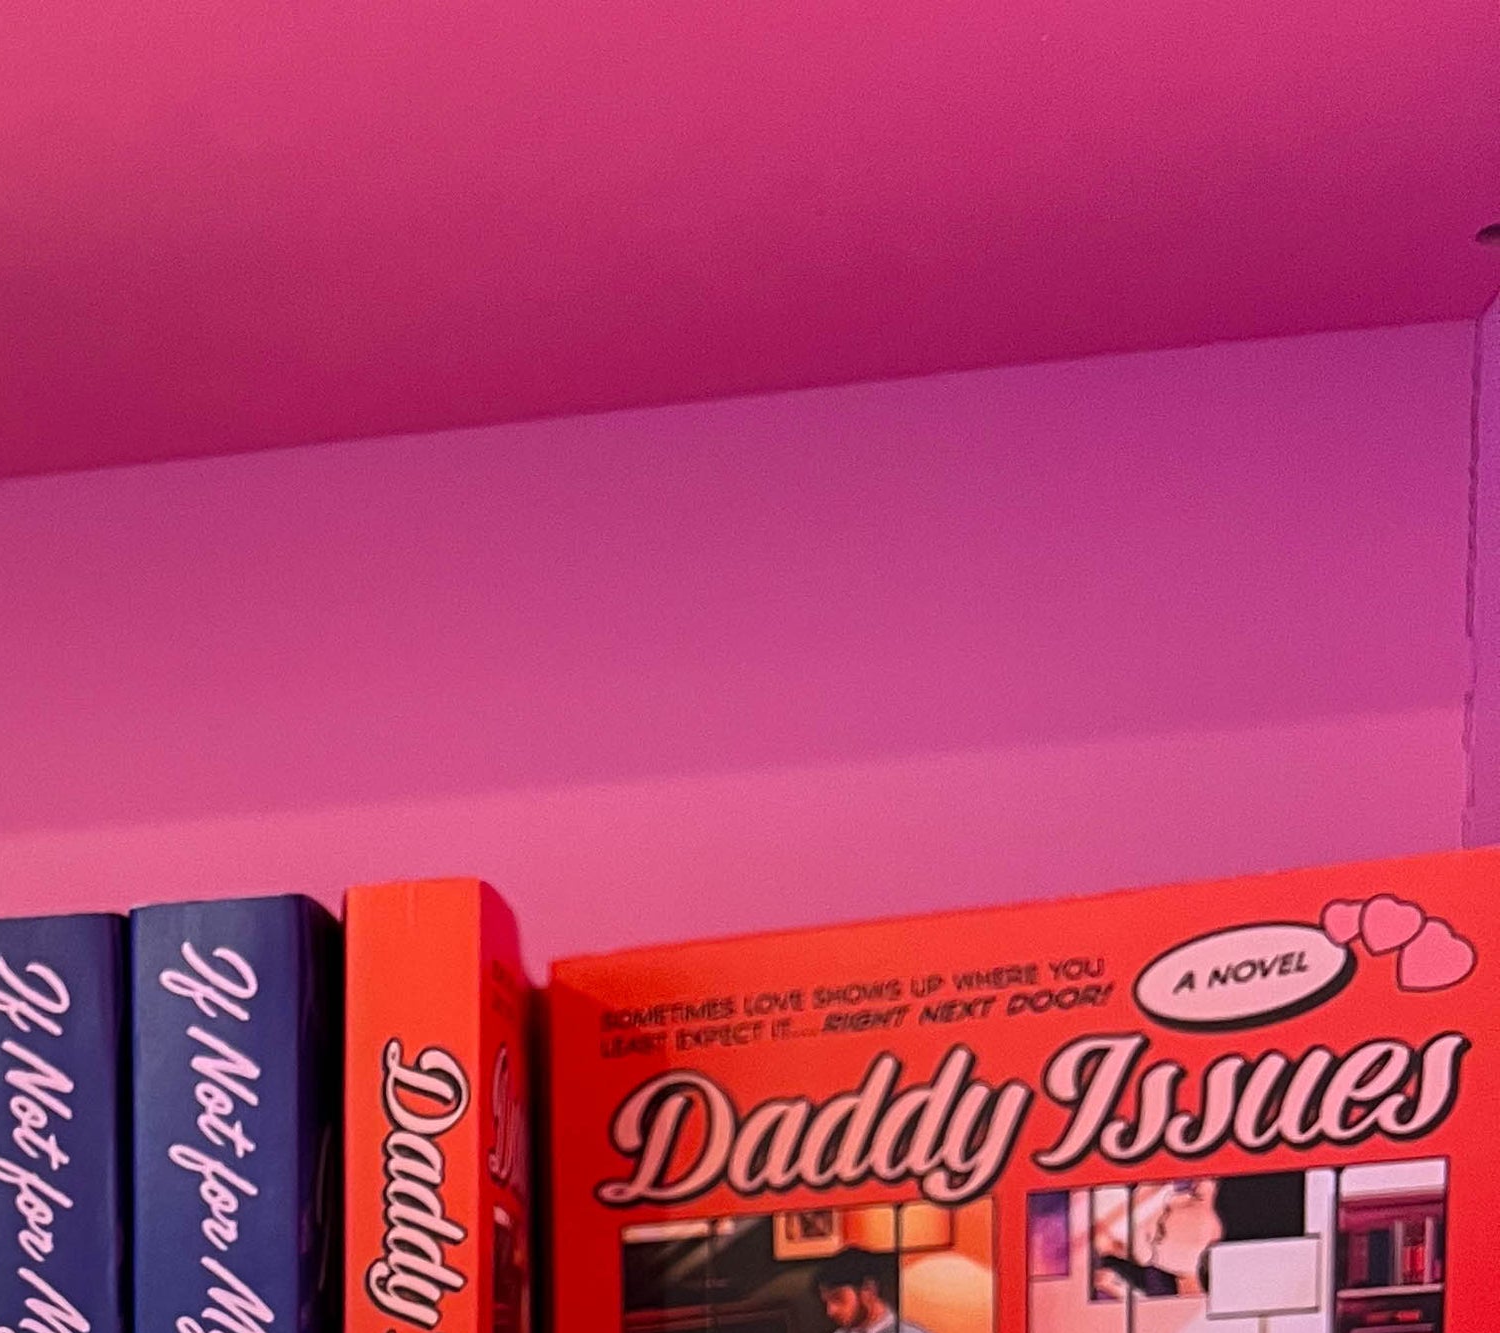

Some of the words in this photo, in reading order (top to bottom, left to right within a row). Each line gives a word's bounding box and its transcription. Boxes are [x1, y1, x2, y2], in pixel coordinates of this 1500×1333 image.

[159, 941, 258, 1022] If
[813, 979, 902, 1008] SHOWS
[910, 974, 944, 998] UP
[953, 963, 1037, 990] WHERE
[1049, 958, 1105, 980] YOU
[918, 995, 997, 1026] NEXT
[1172, 970, 1202, 994] A
[1208, 950, 1310, 987] NOVEL
[2, 1039, 75, 1172] Not
[186, 1025, 261, 1160] Not
[593, 1042, 1033, 1209] Daddy
[1031, 1031, 1473, 1170] Issues
[169, 1142, 258, 1252] for
[366, 1036, 473, 1330] Daddy
